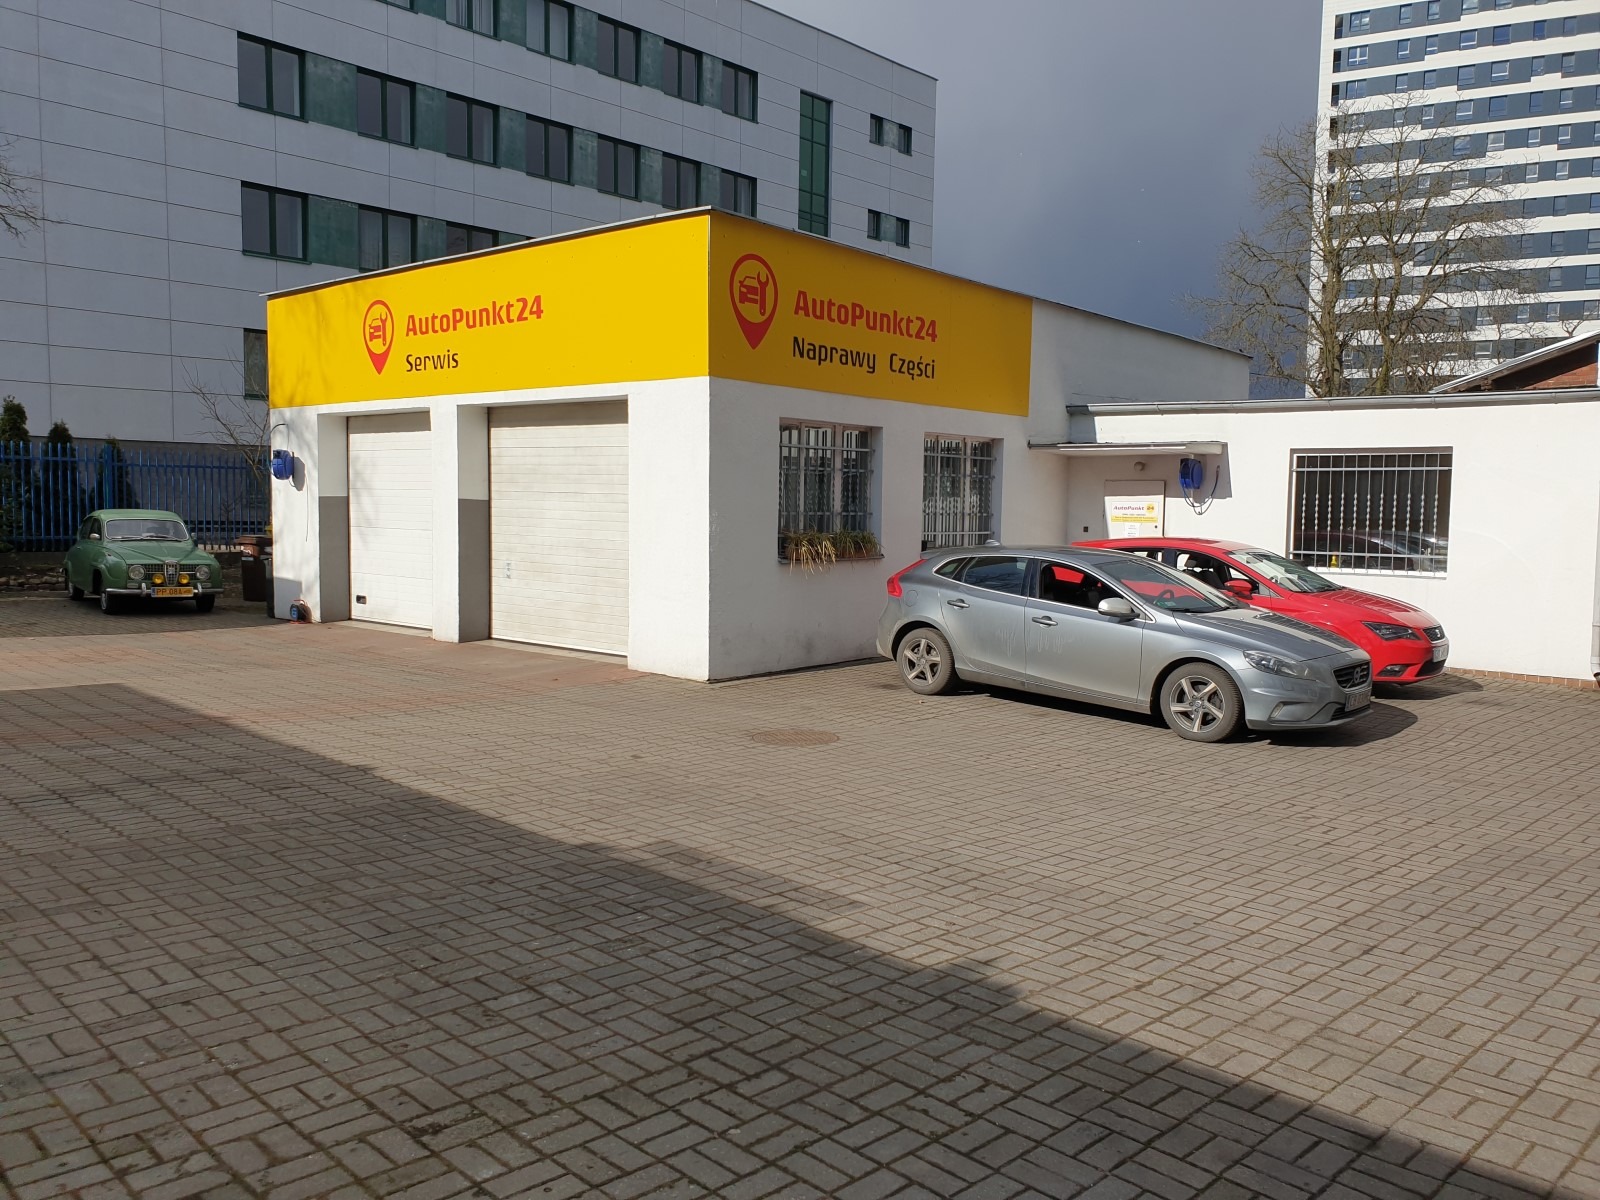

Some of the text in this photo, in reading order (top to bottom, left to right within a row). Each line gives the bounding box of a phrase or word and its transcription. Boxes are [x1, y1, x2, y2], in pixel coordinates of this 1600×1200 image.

[405, 294, 544, 337] AutoPunkt24
[794, 290, 938, 343] AutoPunkt24
[405, 349, 459, 372] Serwis
[792, 336, 936, 381] Naprawy Części
